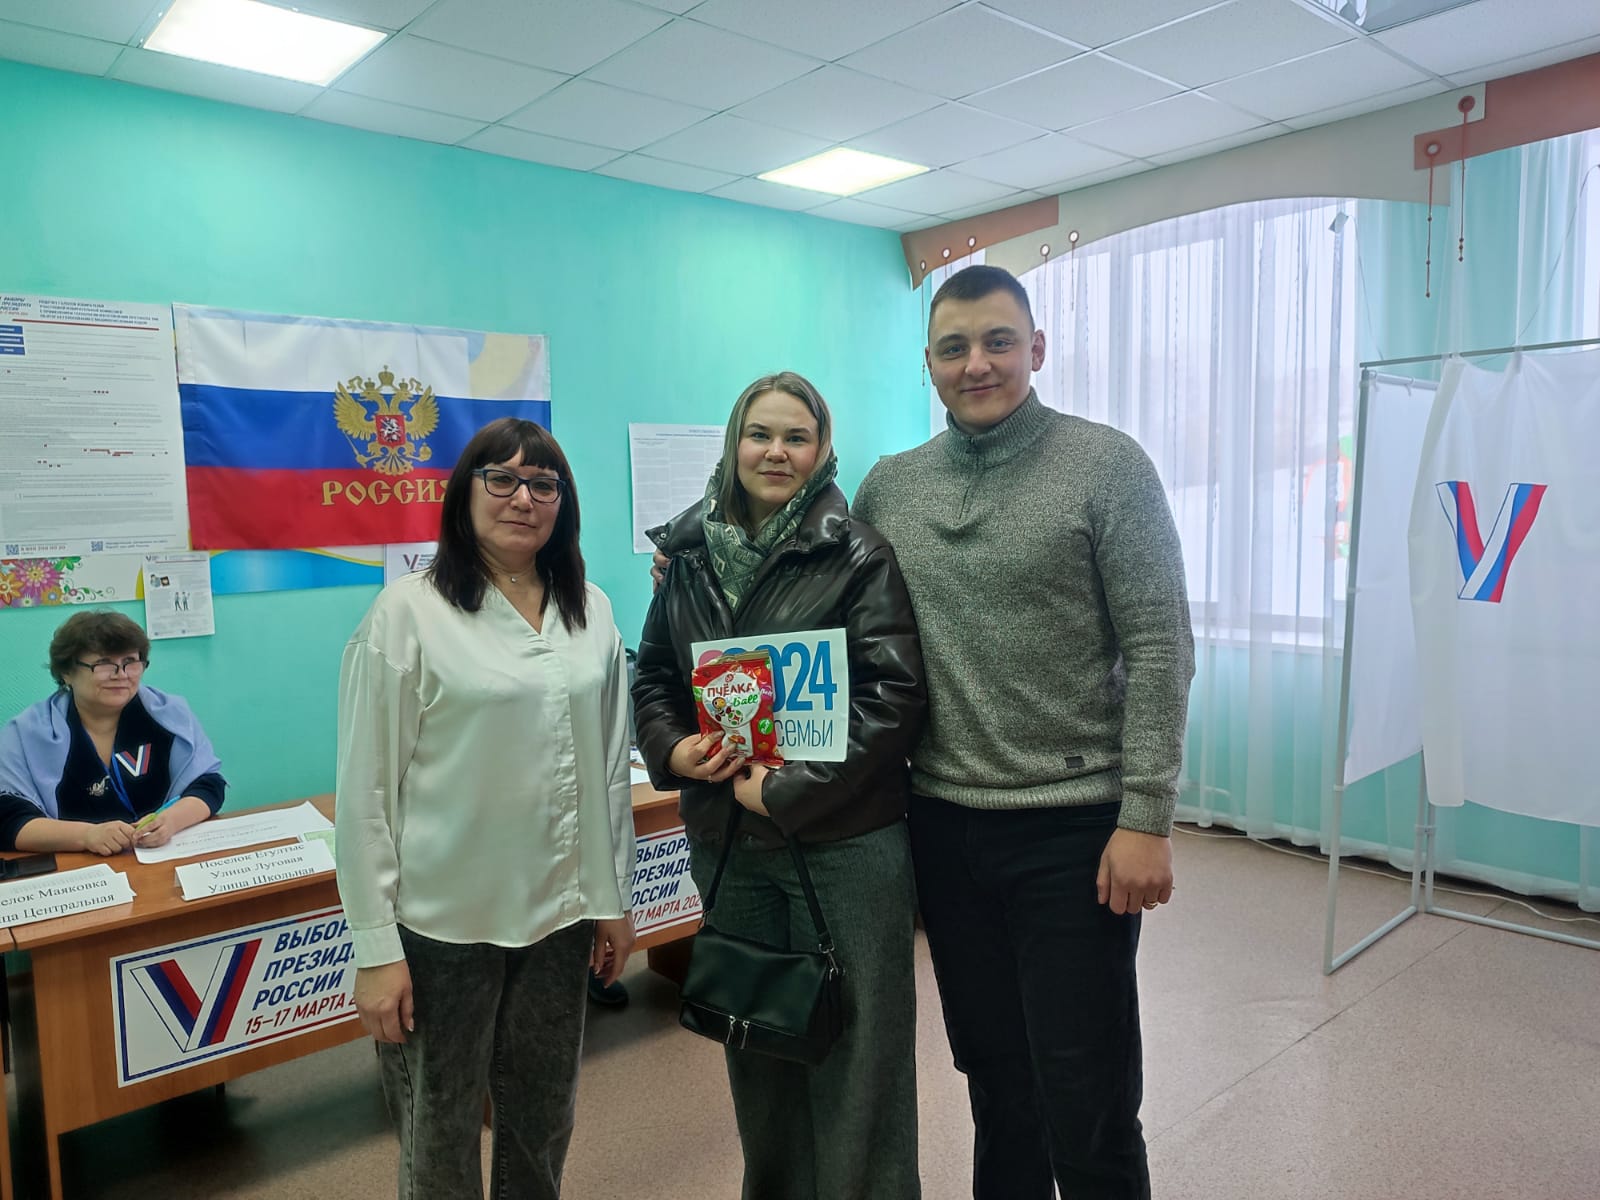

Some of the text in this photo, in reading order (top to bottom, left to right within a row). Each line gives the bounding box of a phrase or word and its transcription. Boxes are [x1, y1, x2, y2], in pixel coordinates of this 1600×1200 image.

[722, 640, 838, 713] 024
[707, 682, 755, 698] ПЧЁЛКА
[199, 854, 252, 869] Поселок
[210, 856, 304, 879] Улица Луговая
[38, 879, 108, 899] Маяковка
[207, 867, 315, 894] Улица Школьная
[23, 893, 115, 918] Центральная
[645, 899, 681, 922] МАРТА
[262, 941, 355, 982] ПРЕЗИД
[252, 968, 345, 1011] РОССИИ
[292, 993, 346, 1022] МАРТА
